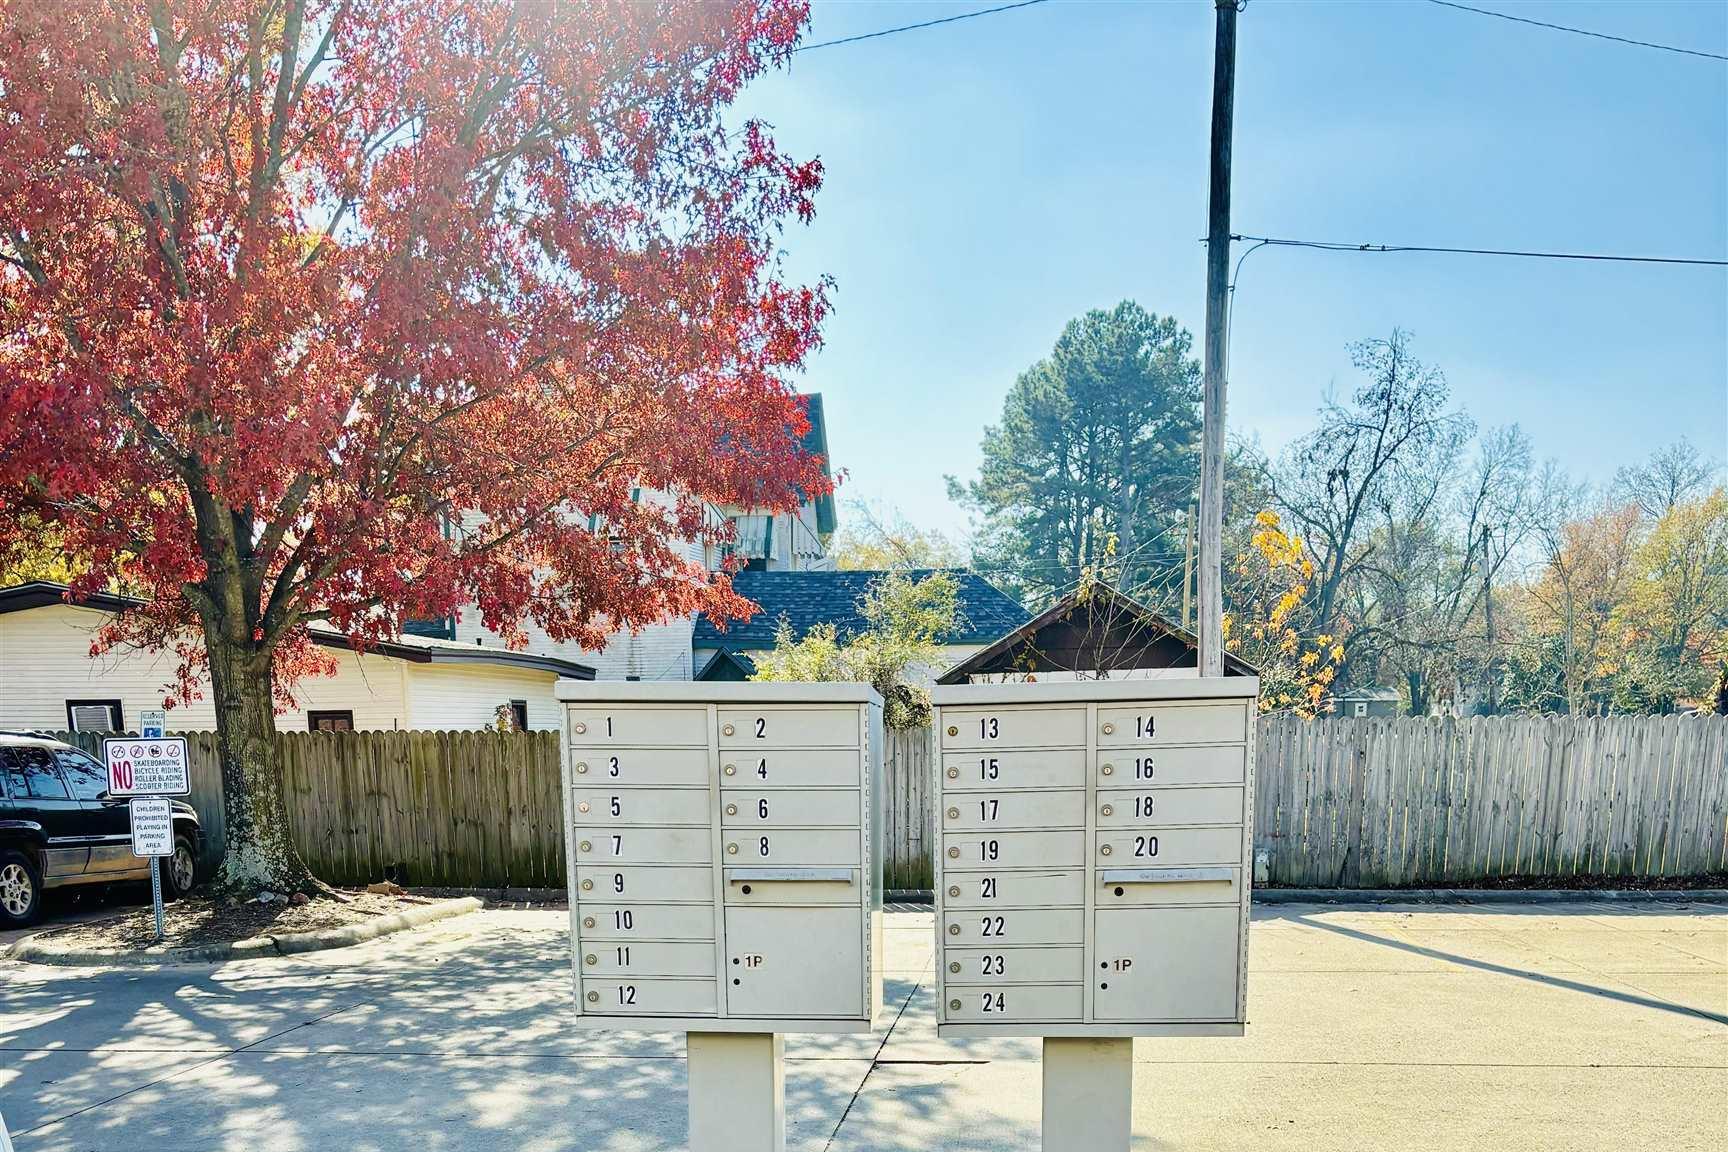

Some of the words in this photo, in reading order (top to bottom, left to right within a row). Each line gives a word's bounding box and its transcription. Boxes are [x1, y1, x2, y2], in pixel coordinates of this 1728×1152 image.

[606, 716, 612, 737] 1
[756, 717, 766, 739] 2
[980, 717, 999, 740] 13
[1136, 715, 1155, 738] 14
[112, 760, 133, 789] NO
[609, 756, 619, 777] 3
[757, 758, 768, 779] 4
[980, 758, 999, 780] 15
[1135, 757, 1154, 779] 16
[158, 774, 183, 782] BLADING
[611, 796, 621, 817] 5
[758, 798, 768, 819] 6
[980, 799, 999, 822] 17
[1135, 796, 1154, 818] 18
[612, 835, 622, 856] 7
[759, 836, 769, 857] 8
[980, 839, 999, 861] 19
[1134, 836, 1159, 857] 20
[614, 873, 624, 893] 9
[981, 877, 997, 899] 21
[615, 910, 633, 930] 10
[982, 916, 1005, 937] 22
[616, 946, 630, 966] 11
[745, 955, 763, 968] 1P
[982, 955, 1005, 975] 23
[1113, 959, 1132, 972] 1P
[618, 985, 636, 1005] 12
[982, 992, 1005, 1012] 24
